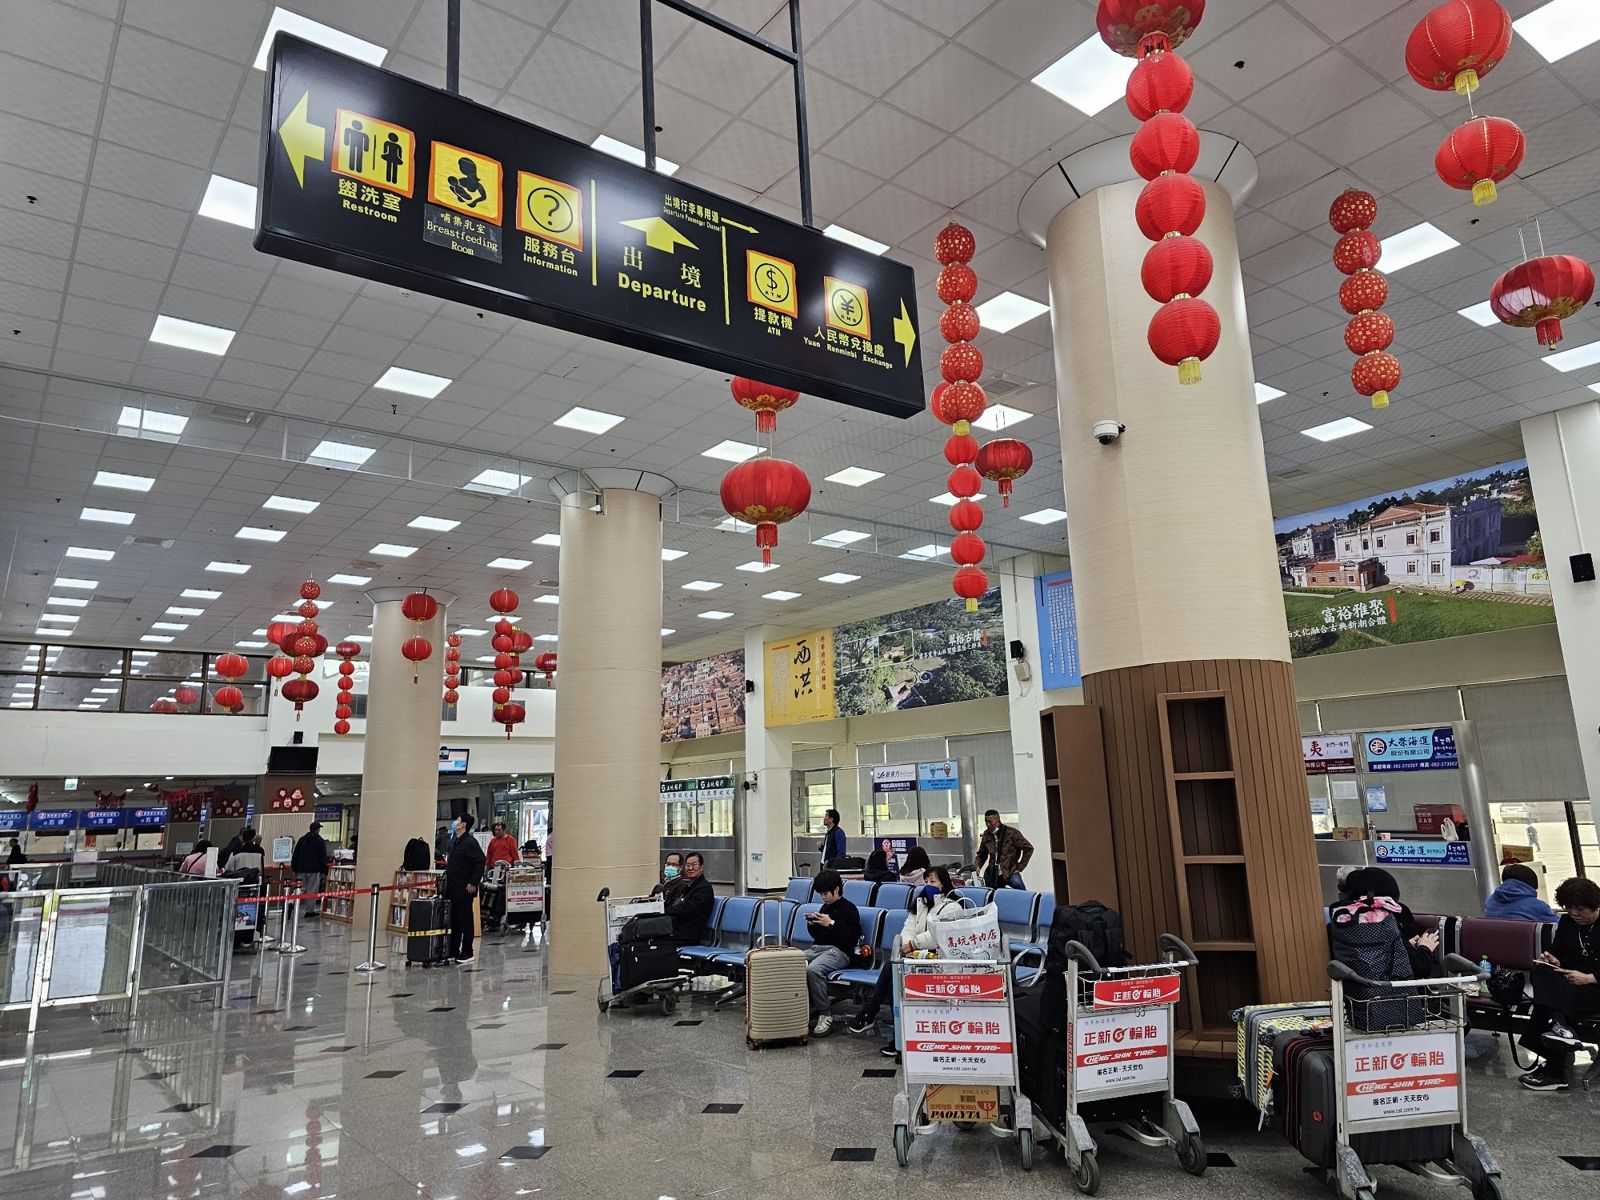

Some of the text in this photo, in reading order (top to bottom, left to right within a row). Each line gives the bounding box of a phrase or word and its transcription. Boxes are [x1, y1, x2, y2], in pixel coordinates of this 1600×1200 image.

[338, 178, 402, 212] 盥洗室
[342, 198, 398, 223] Restroom
[440, 212, 486, 235] 哺集乳室
[426, 220, 498, 252] Breastfeeding
[450, 240, 474, 256] Room
[524, 236, 575, 265] 服務台
[523, 253, 578, 277] Information
[623, 245, 702, 289] 出 境
[618, 271, 707, 312] Departure
[753, 306, 793, 331] 提款機
[767, 326, 781, 337] ATM
[803, 336, 893, 370] Yuan Renminbi Exchange
[1321, 598, 1386, 624] 富裕雅聚
[1303, 740, 1324, 758] 夷
[925, 984, 981, 994] 正新 輪胎
[1113, 987, 1161, 1001] 正新 輪胎
[916, 1021, 1000, 1035] 正新 輪胎
[1083, 1025, 1158, 1047] 正新 輪胎
[916, 1042, 949, 1051] CHENG
[1083, 1049, 1158, 1065] CHENG SHIN TIRE
[1354, 1051, 1445, 1073] 正新 輪胎
[1355, 1078, 1446, 1093] CHENG SHIN TIRE
[930, 1110, 981, 1119] PAOLYTA
